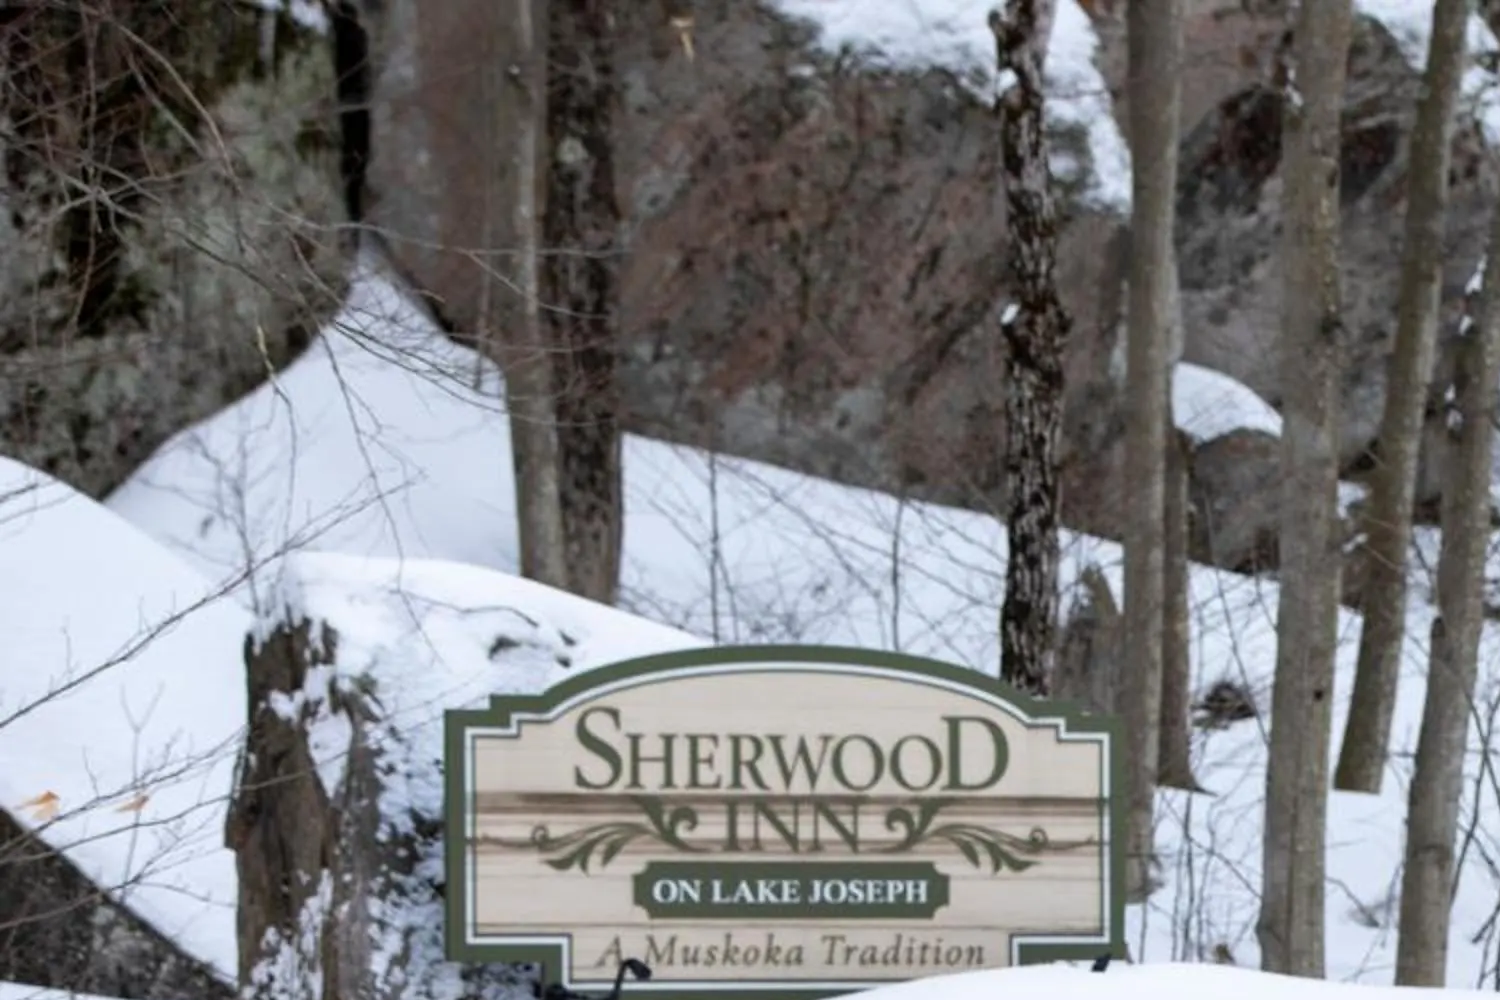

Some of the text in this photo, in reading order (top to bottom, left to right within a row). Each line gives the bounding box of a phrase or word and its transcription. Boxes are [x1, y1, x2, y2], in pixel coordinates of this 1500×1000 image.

[575, 706, 1010, 791] SHERWOOD
[721, 797, 869, 854] INN
[652, 879, 928, 904] ON LAKE JOSEPH
[594, 932, 985, 968] A Muskoka Tradition
